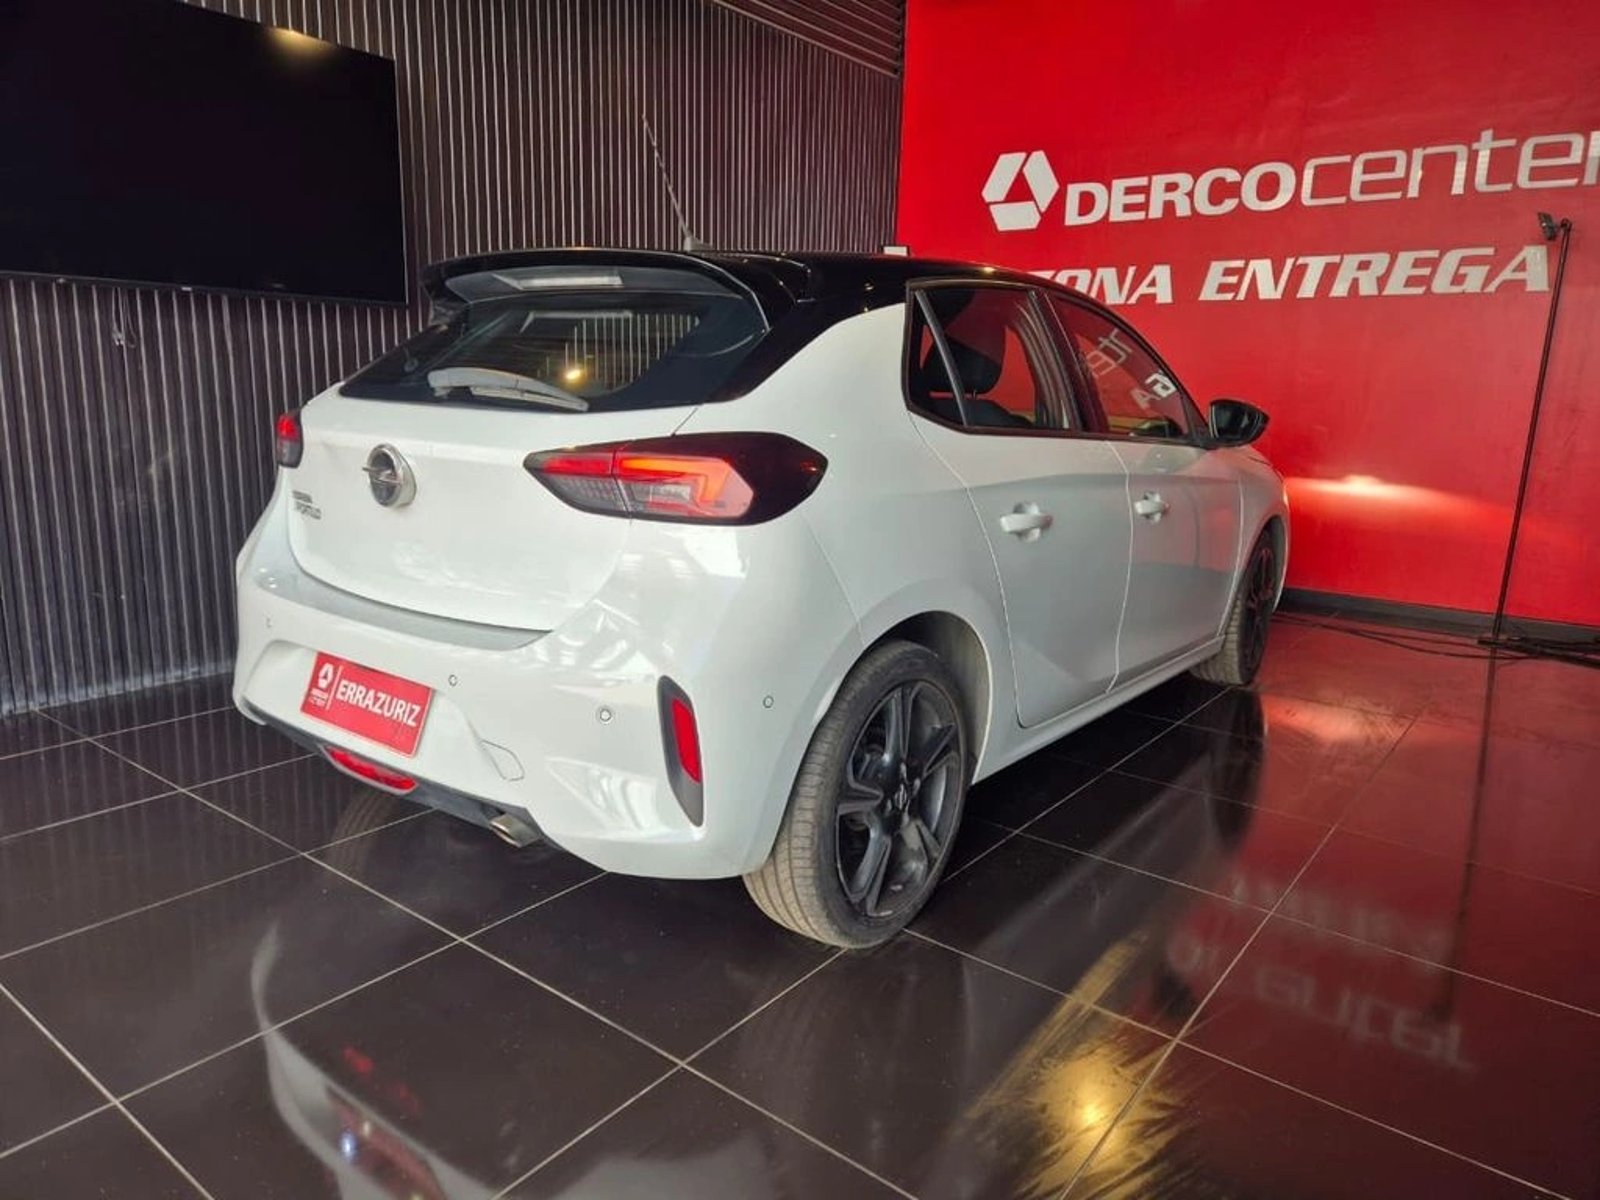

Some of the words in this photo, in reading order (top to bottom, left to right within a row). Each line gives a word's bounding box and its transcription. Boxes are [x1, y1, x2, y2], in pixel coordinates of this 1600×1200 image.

[1026, 264, 1174, 305] ONA
[1198, 245, 1550, 301] ENTREGA
[335, 679, 421, 728] ERRAZURIZ
